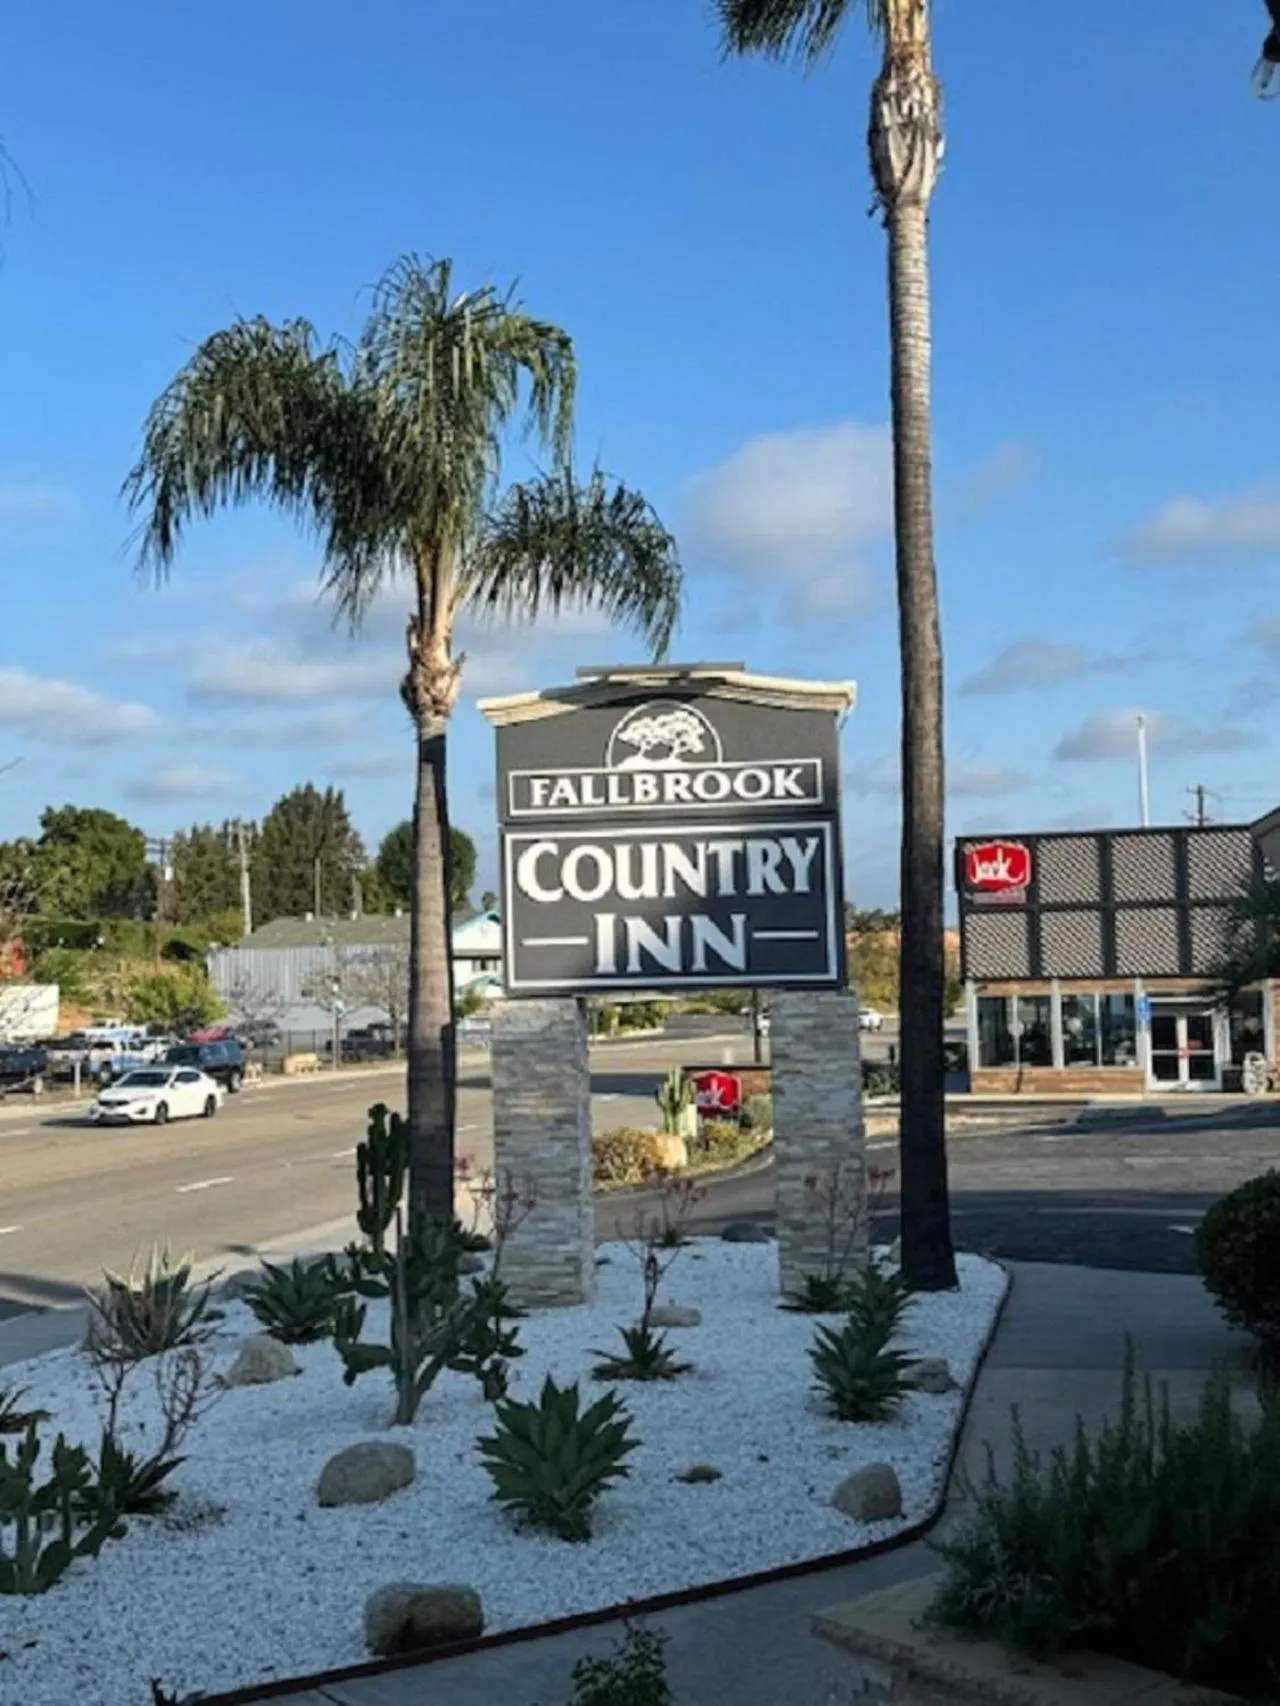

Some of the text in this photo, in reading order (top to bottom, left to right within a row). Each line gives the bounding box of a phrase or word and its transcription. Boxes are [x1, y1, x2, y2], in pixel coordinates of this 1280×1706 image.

[530, 767, 805, 806] FALLBROOK
[516, 837, 820, 902] COUNTRY
[594, 912, 747, 974] INN
